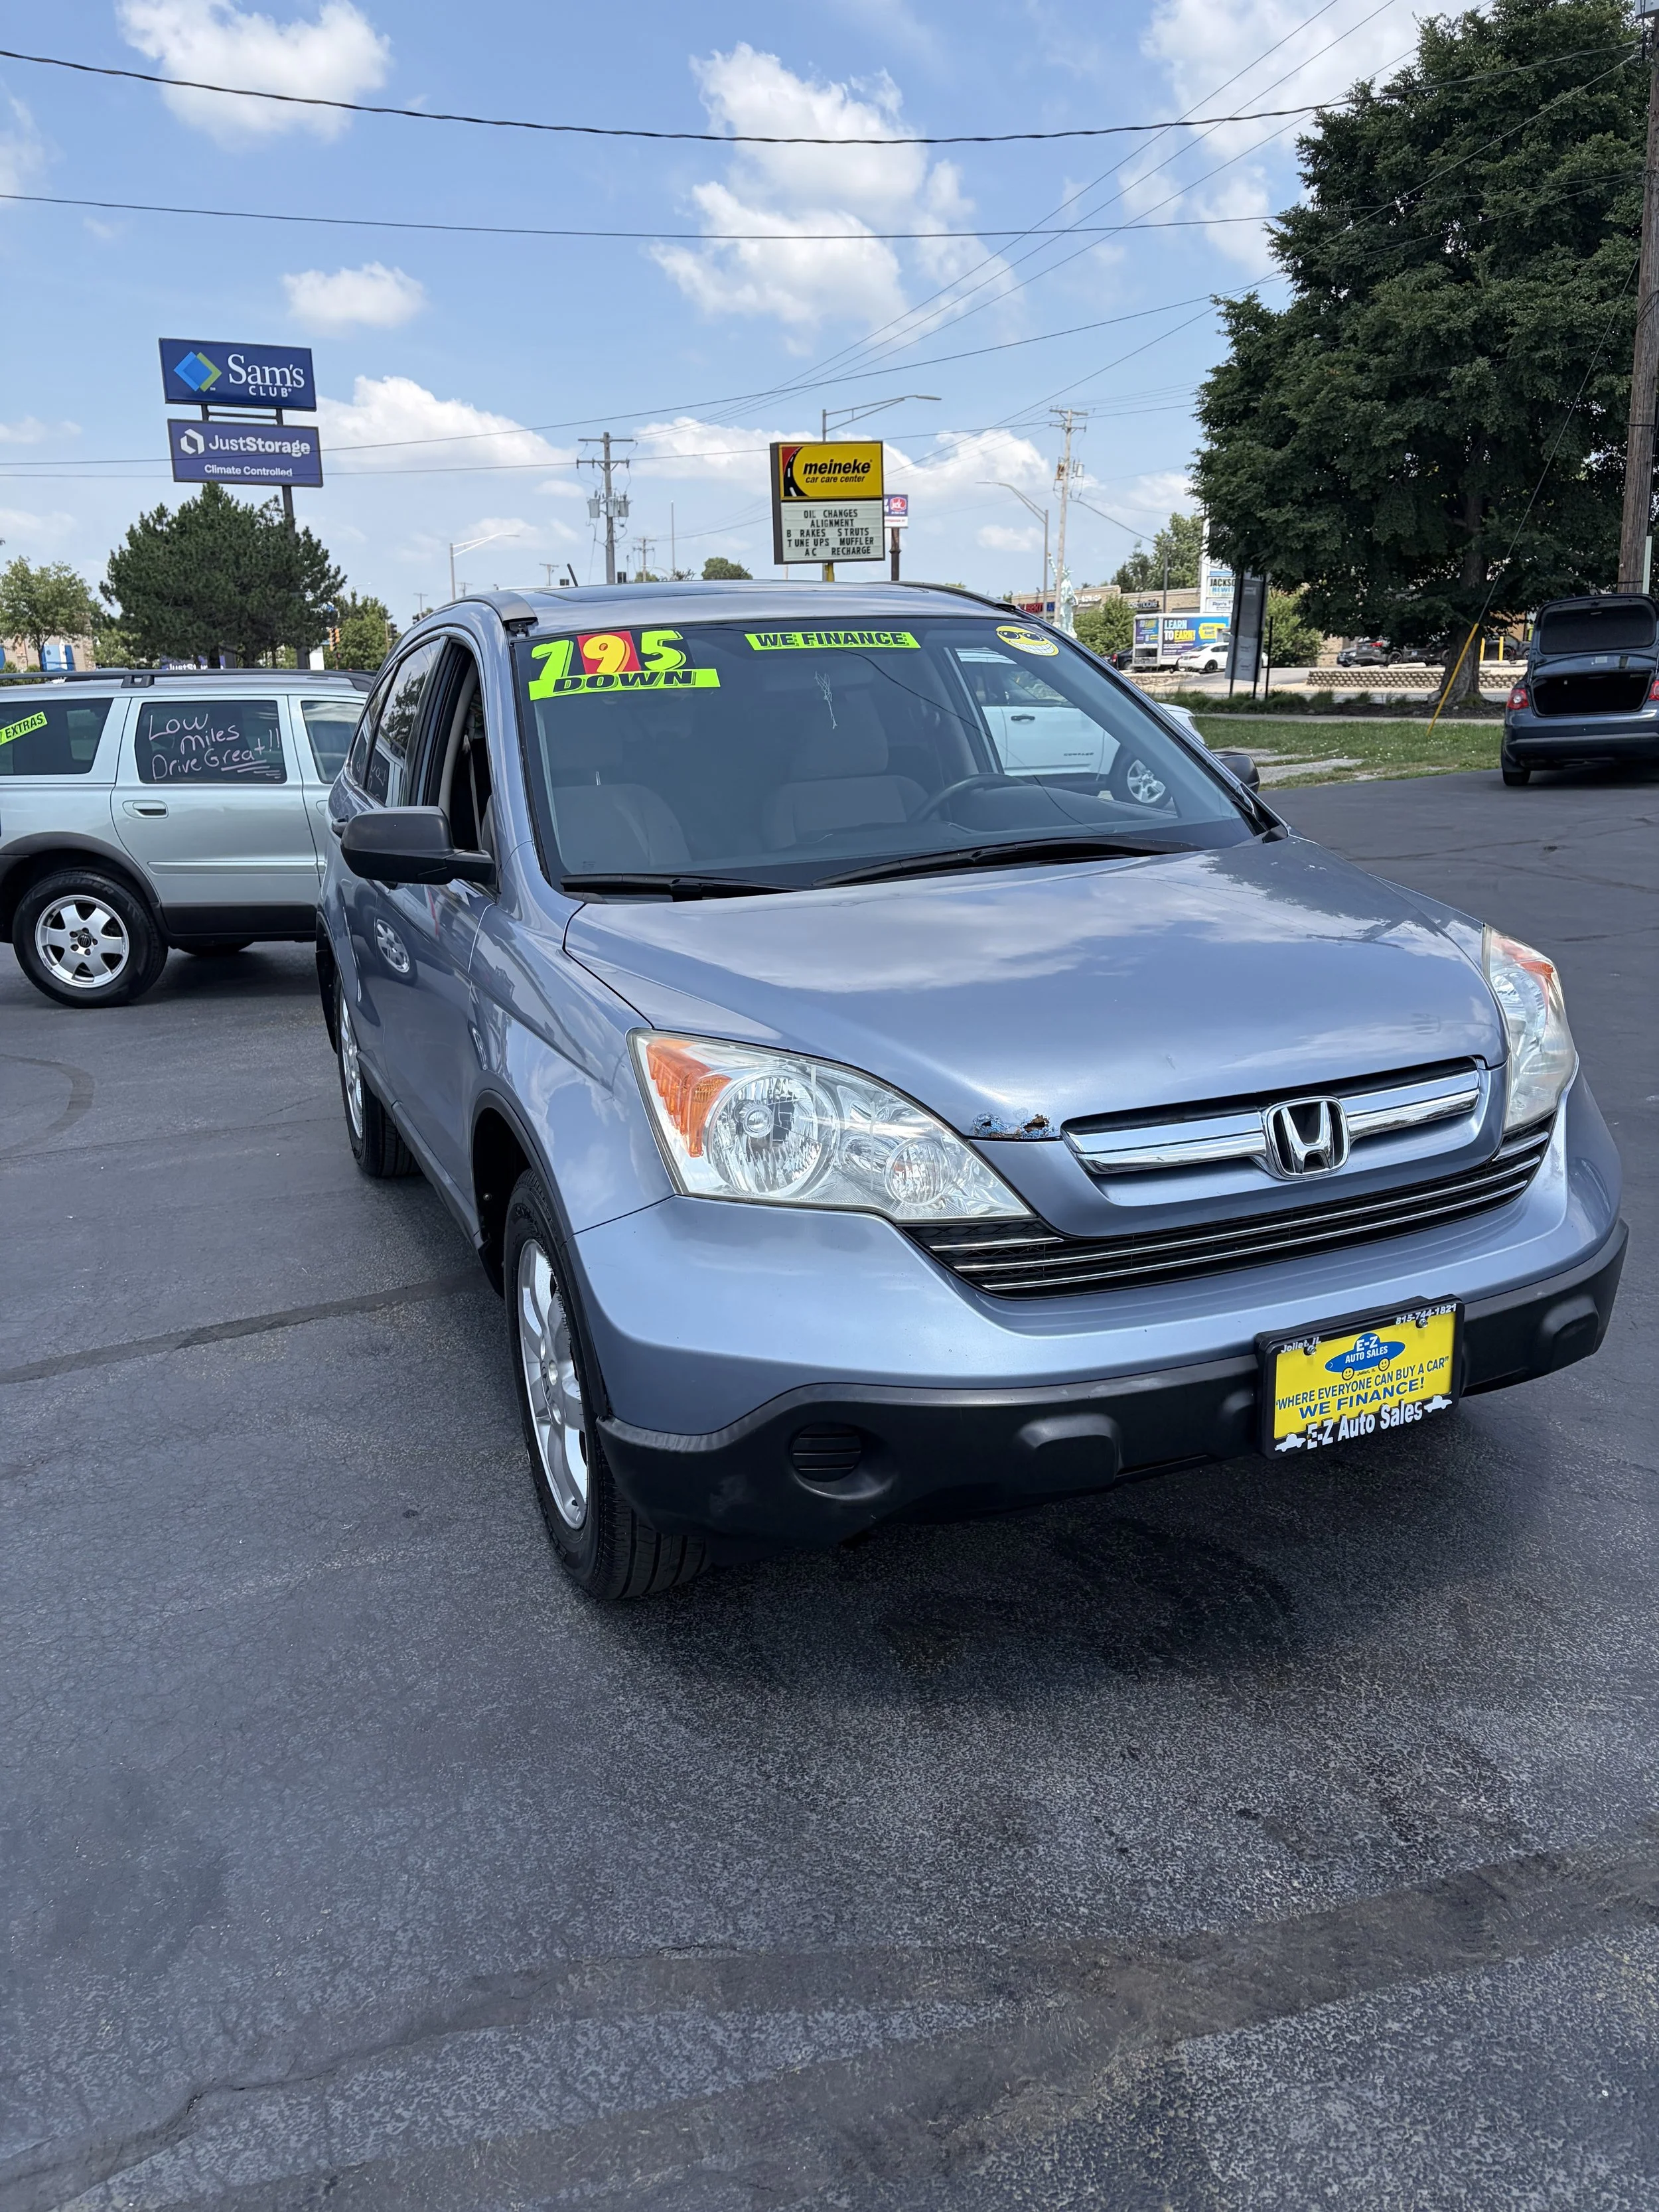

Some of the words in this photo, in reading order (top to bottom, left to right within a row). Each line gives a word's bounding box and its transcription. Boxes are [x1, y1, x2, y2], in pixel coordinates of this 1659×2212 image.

[228, 354, 305, 388] Sam's
[248, 386, 288, 398] CLUB
[208, 435, 311, 457] JustStorage
[204, 464, 242, 475] Climate
[243, 466, 293, 477] Controlled
[803, 459, 871, 475] meineke
[804, 510, 816, 518] OIL
[823, 509, 858, 518] CHANGES
[810, 518, 854, 528] ALIGNMENT
[837, 528, 869, 537] STRUTS
[814, 538, 830, 547] UPS
[839, 537, 874, 546] MUFFLER
[831, 546, 871, 555] RECHARGE
[1210, 578, 1236, 587] JACKSO
[1164, 620, 1187, 630] LEARN
[755, 634, 798, 647] WE
[802, 632, 908, 646] FINANCE
[1164, 630, 1174, 640] TO
[1174, 629, 1196, 641] EARN!
[532, 630, 687, 680] 795
[553, 670, 695, 694] DOWN
[5, 714, 44, 739] EXTRAS
[149, 713, 208, 741] Low
[152, 754, 202, 781] Drive
[1396, 1303, 1457, 1325] 815-744-1821
[1312, 1337, 1321, 1345] IL
[1356, 1335, 1378, 1352] E-Z
[1345, 1351, 1364, 1364] AUTO
[1366, 1345, 1388, 1359] SALES
[1318, 1376, 1372, 1400] EVERYONE
[1374, 1370, 1394, 1386] CAN
[1396, 1364, 1416, 1380] BUY
[1417, 1363, 1425, 1375] A
[1299, 1401, 1331, 1420] WE
[1337, 1376, 1425, 1411] FINANCE!
[1307, 1419, 1334, 1449] E-Z
[1337, 1411, 1376, 1441] Auto
[1380, 1400, 1423, 1430] Sales
